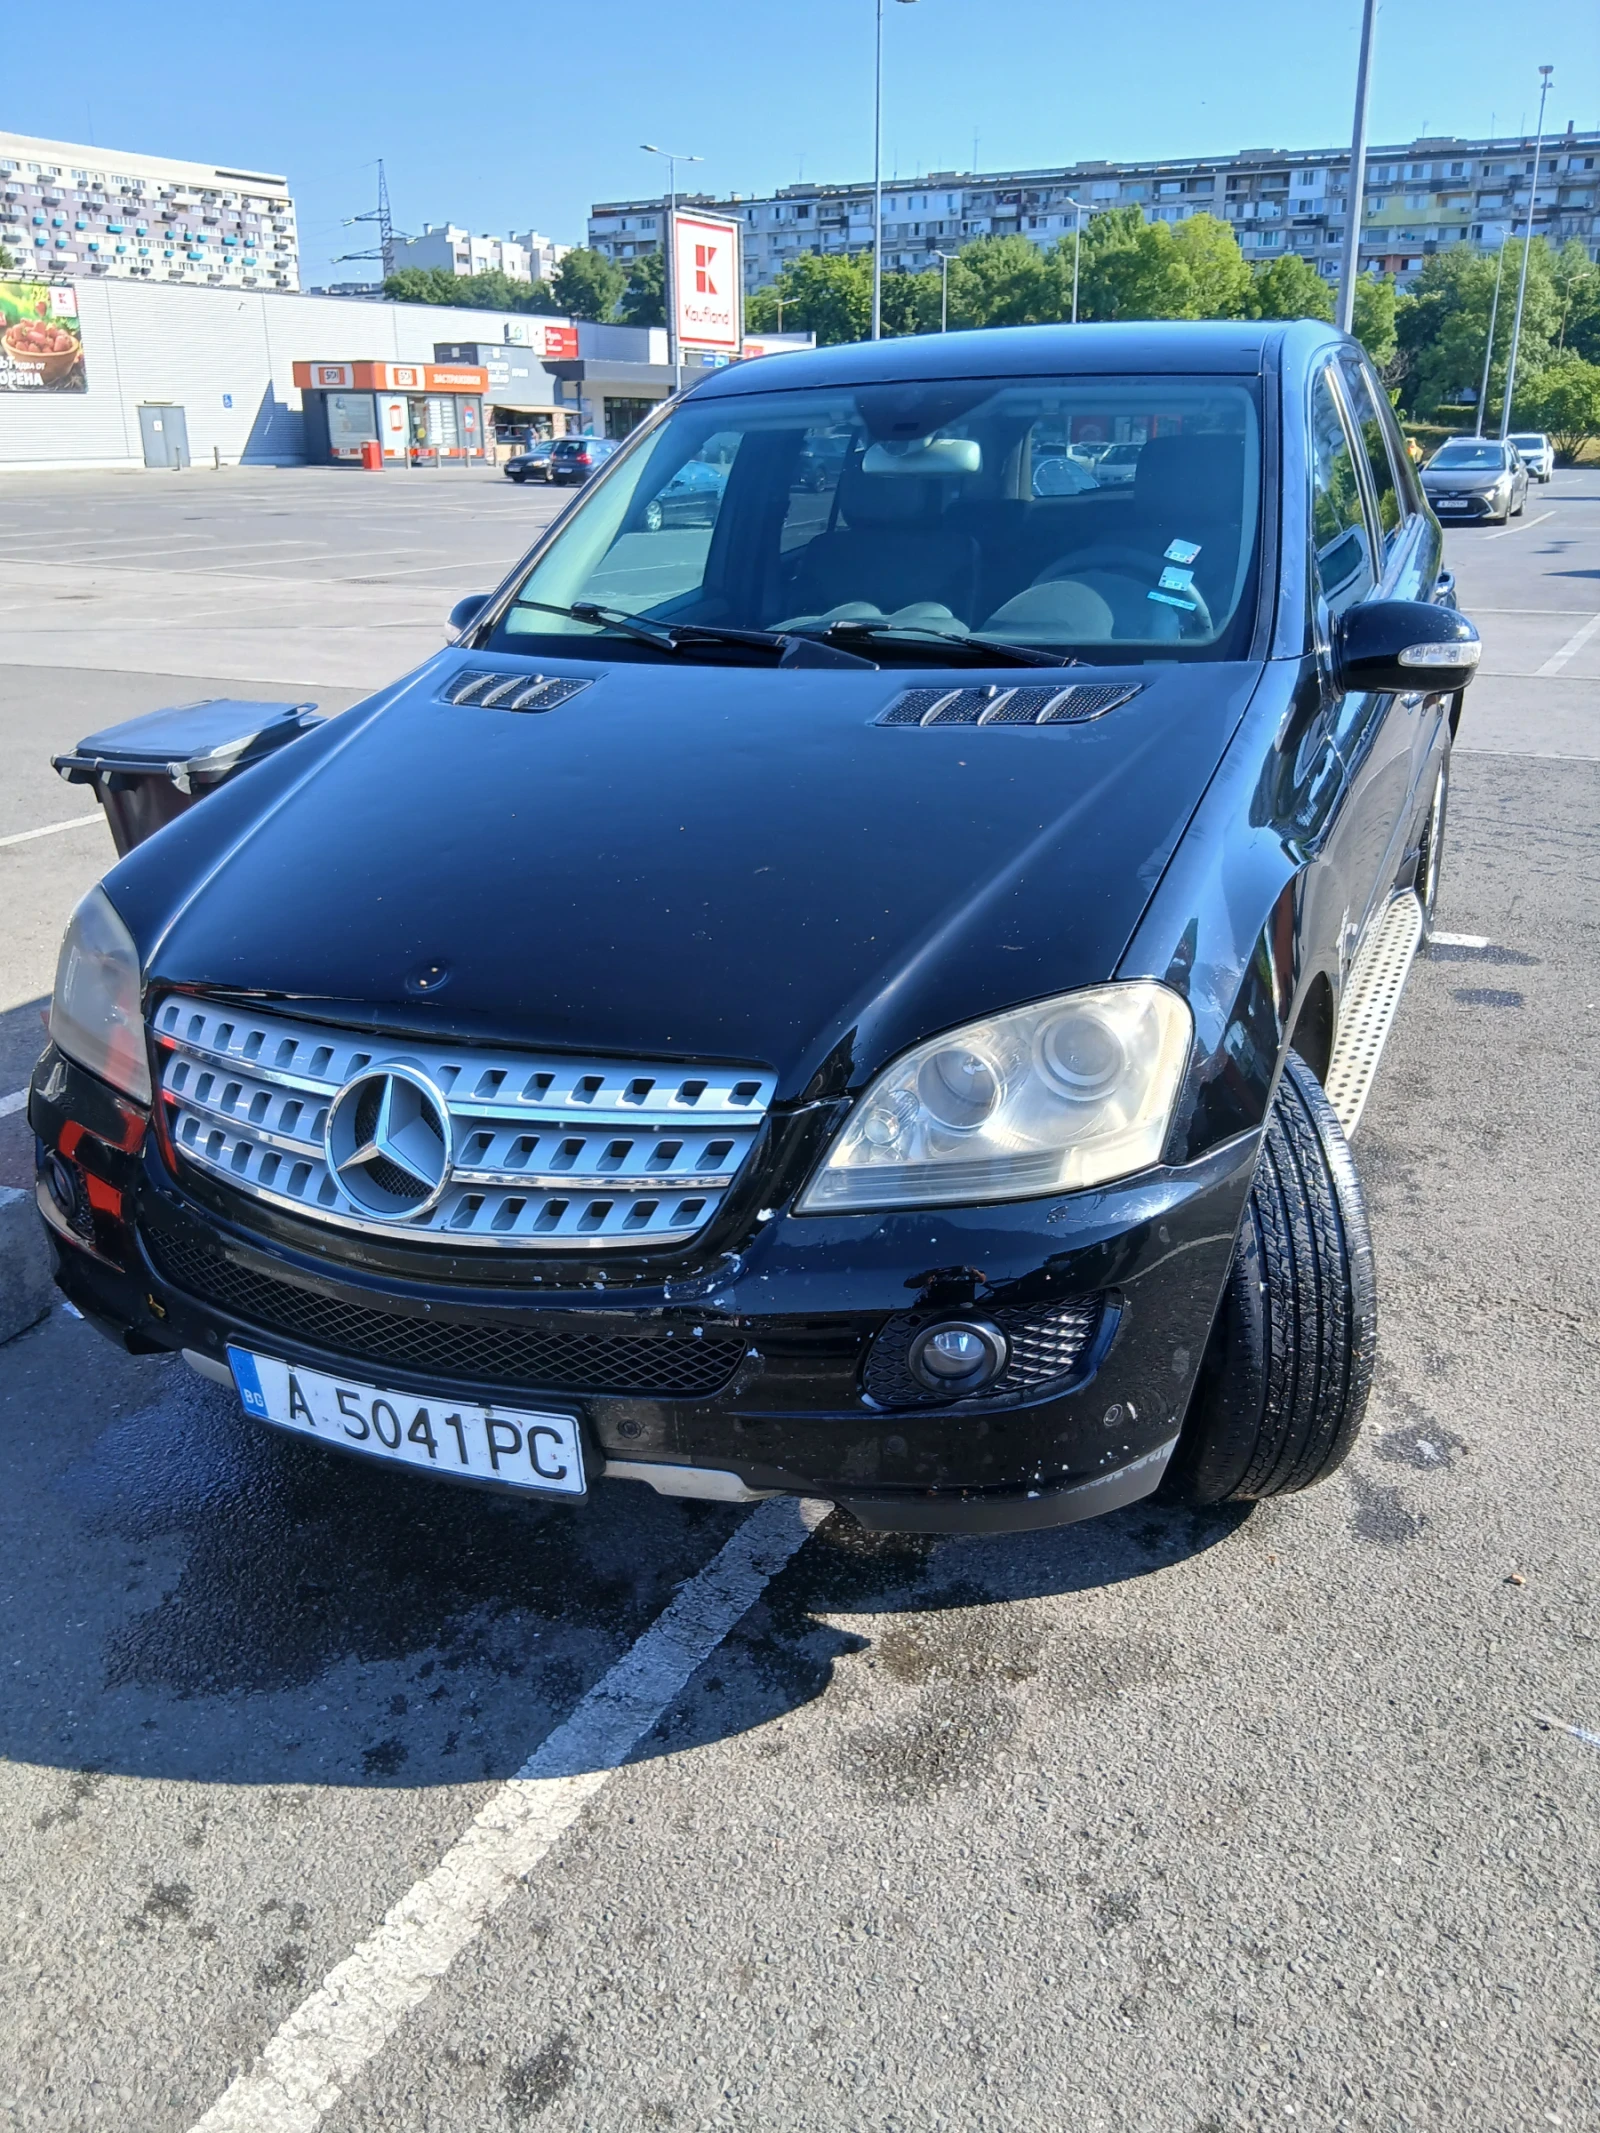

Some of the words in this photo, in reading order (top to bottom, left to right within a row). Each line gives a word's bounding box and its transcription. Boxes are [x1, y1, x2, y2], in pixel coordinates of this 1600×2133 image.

[684, 304, 730, 325] Kaufland
[244, 1388, 265, 1408] BG
[288, 1372, 317, 1427] A
[335, 1387, 469, 1466] 5041
[484, 1416, 568, 1480] PC
